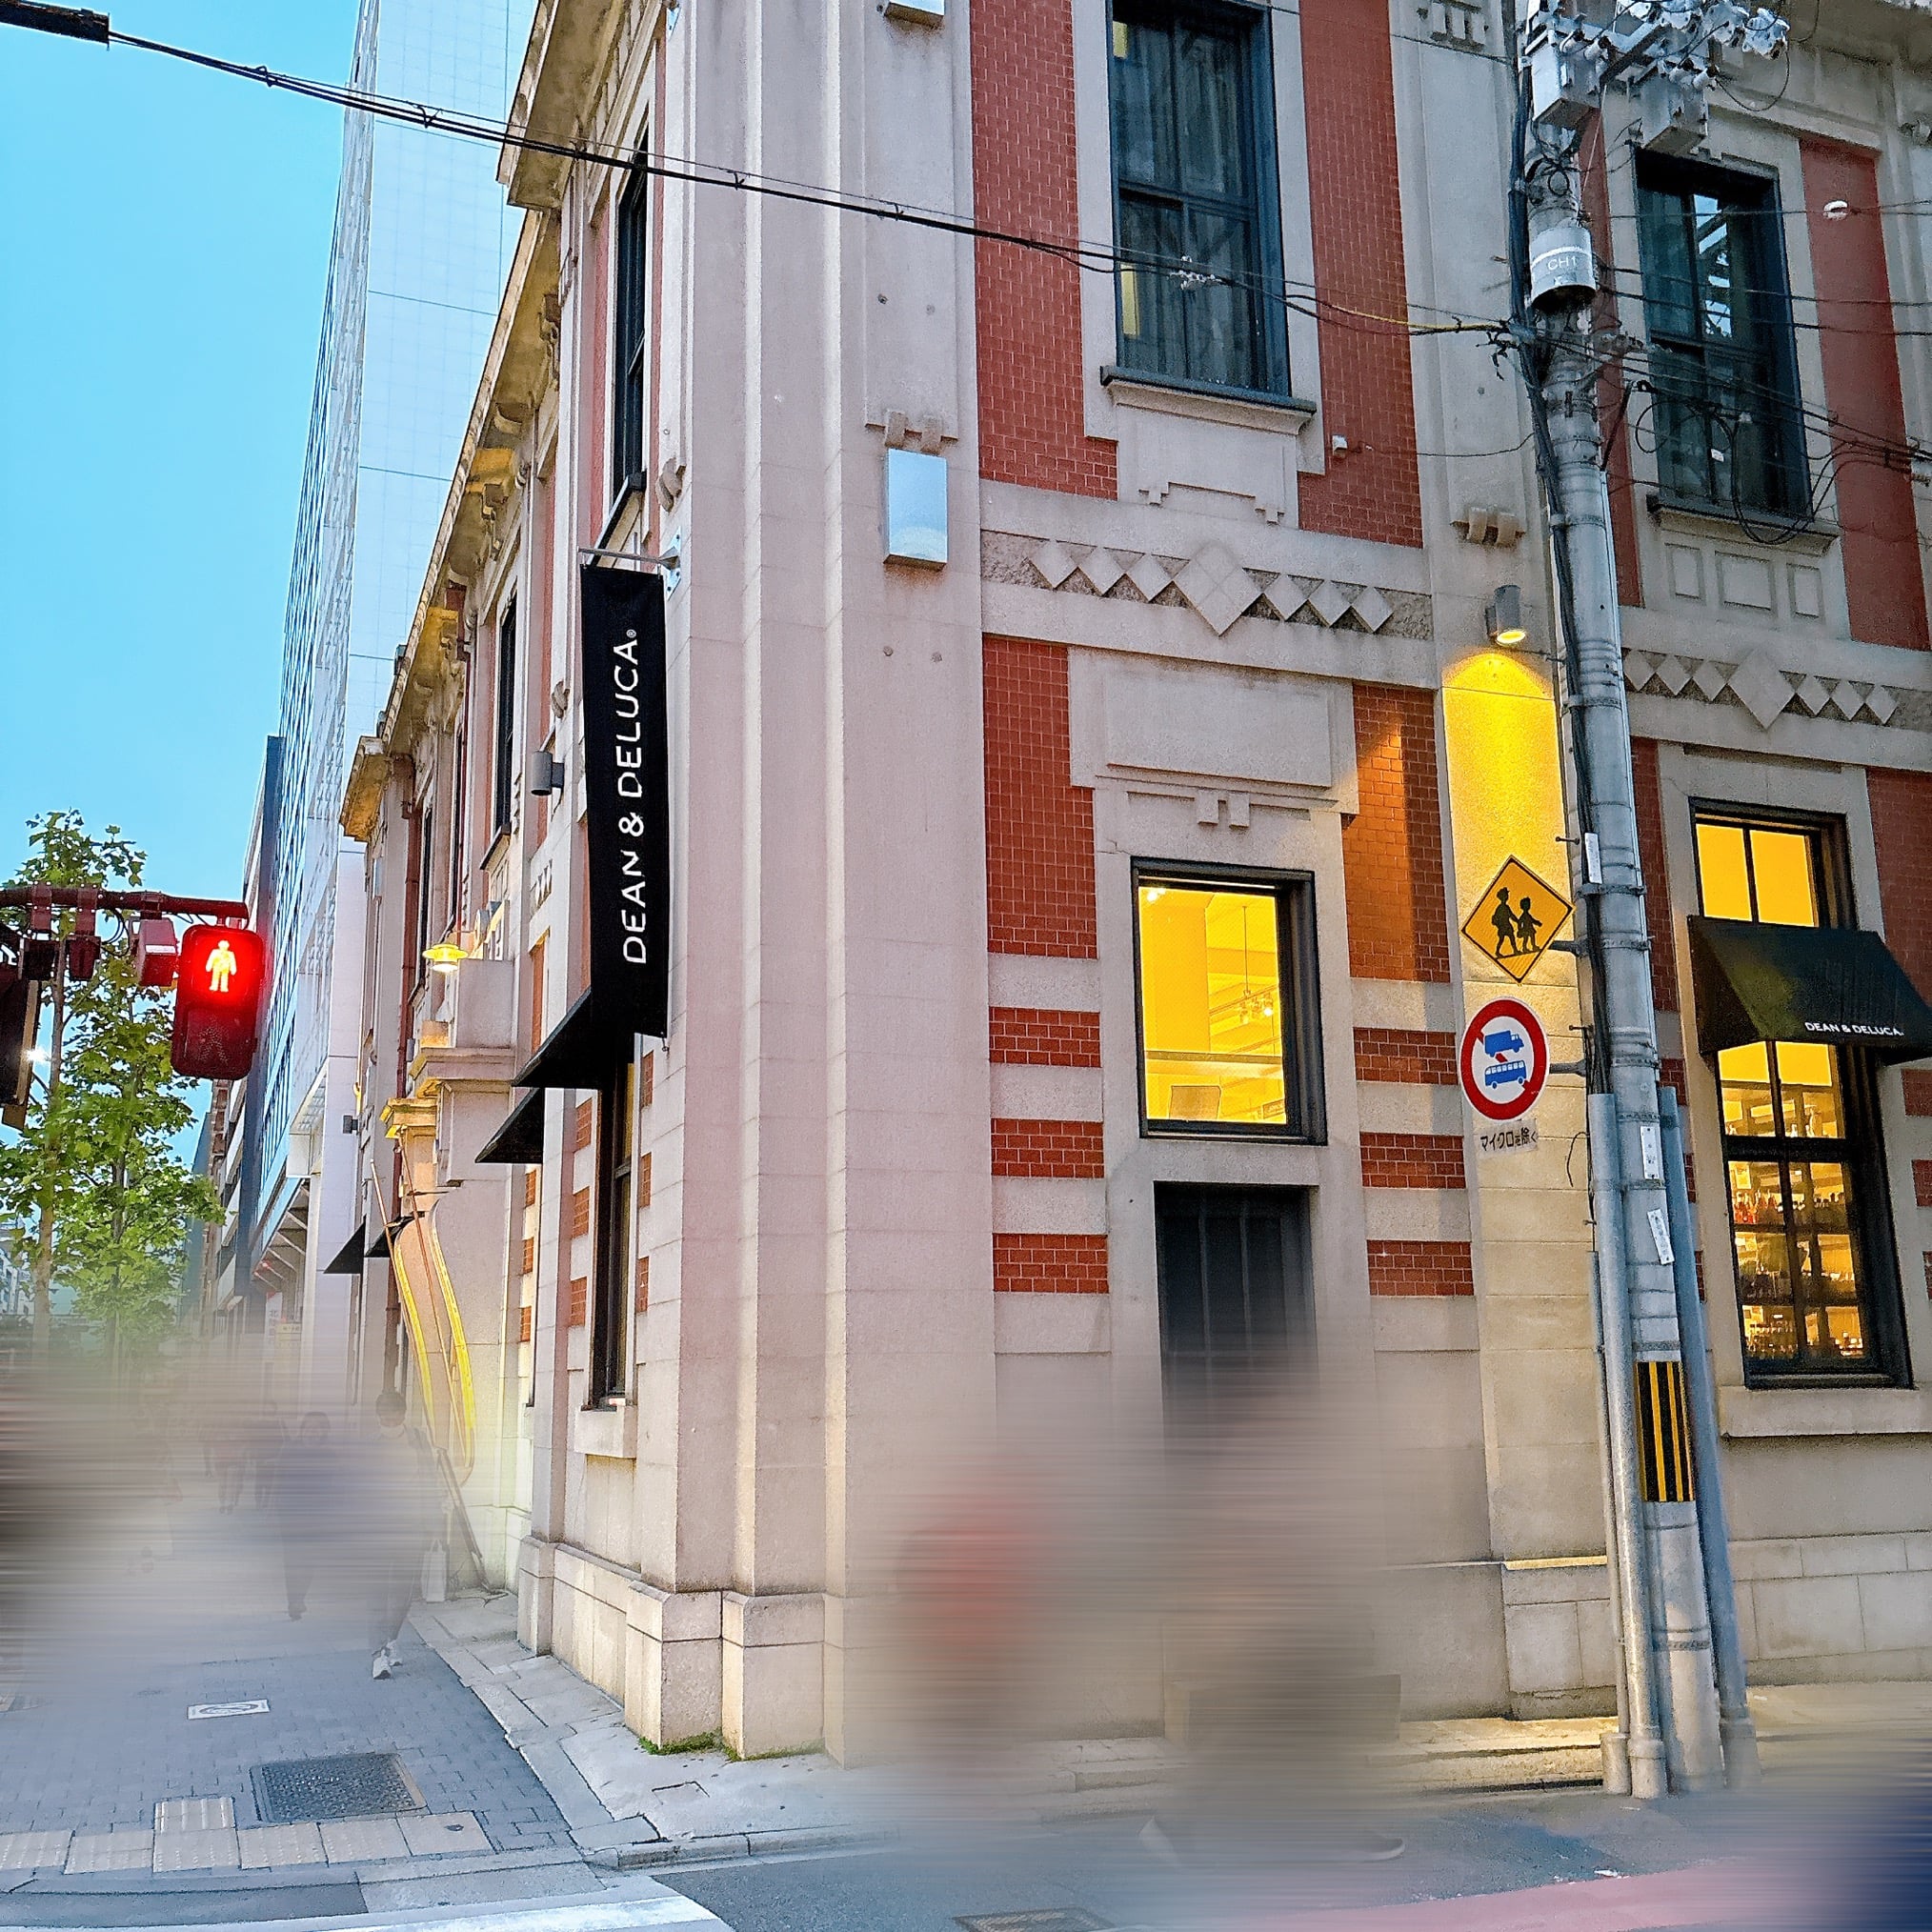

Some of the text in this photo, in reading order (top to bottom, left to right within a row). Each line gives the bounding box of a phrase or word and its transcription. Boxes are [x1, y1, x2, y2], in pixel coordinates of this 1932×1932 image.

[618, 813, 645, 837] &
[620, 849, 647, 964] DEAN
[1804, 1021, 1841, 1033] DEAN
[1841, 1024, 1852, 1033] &
[1479, 1126, 1538, 1152] マイクロを除く
